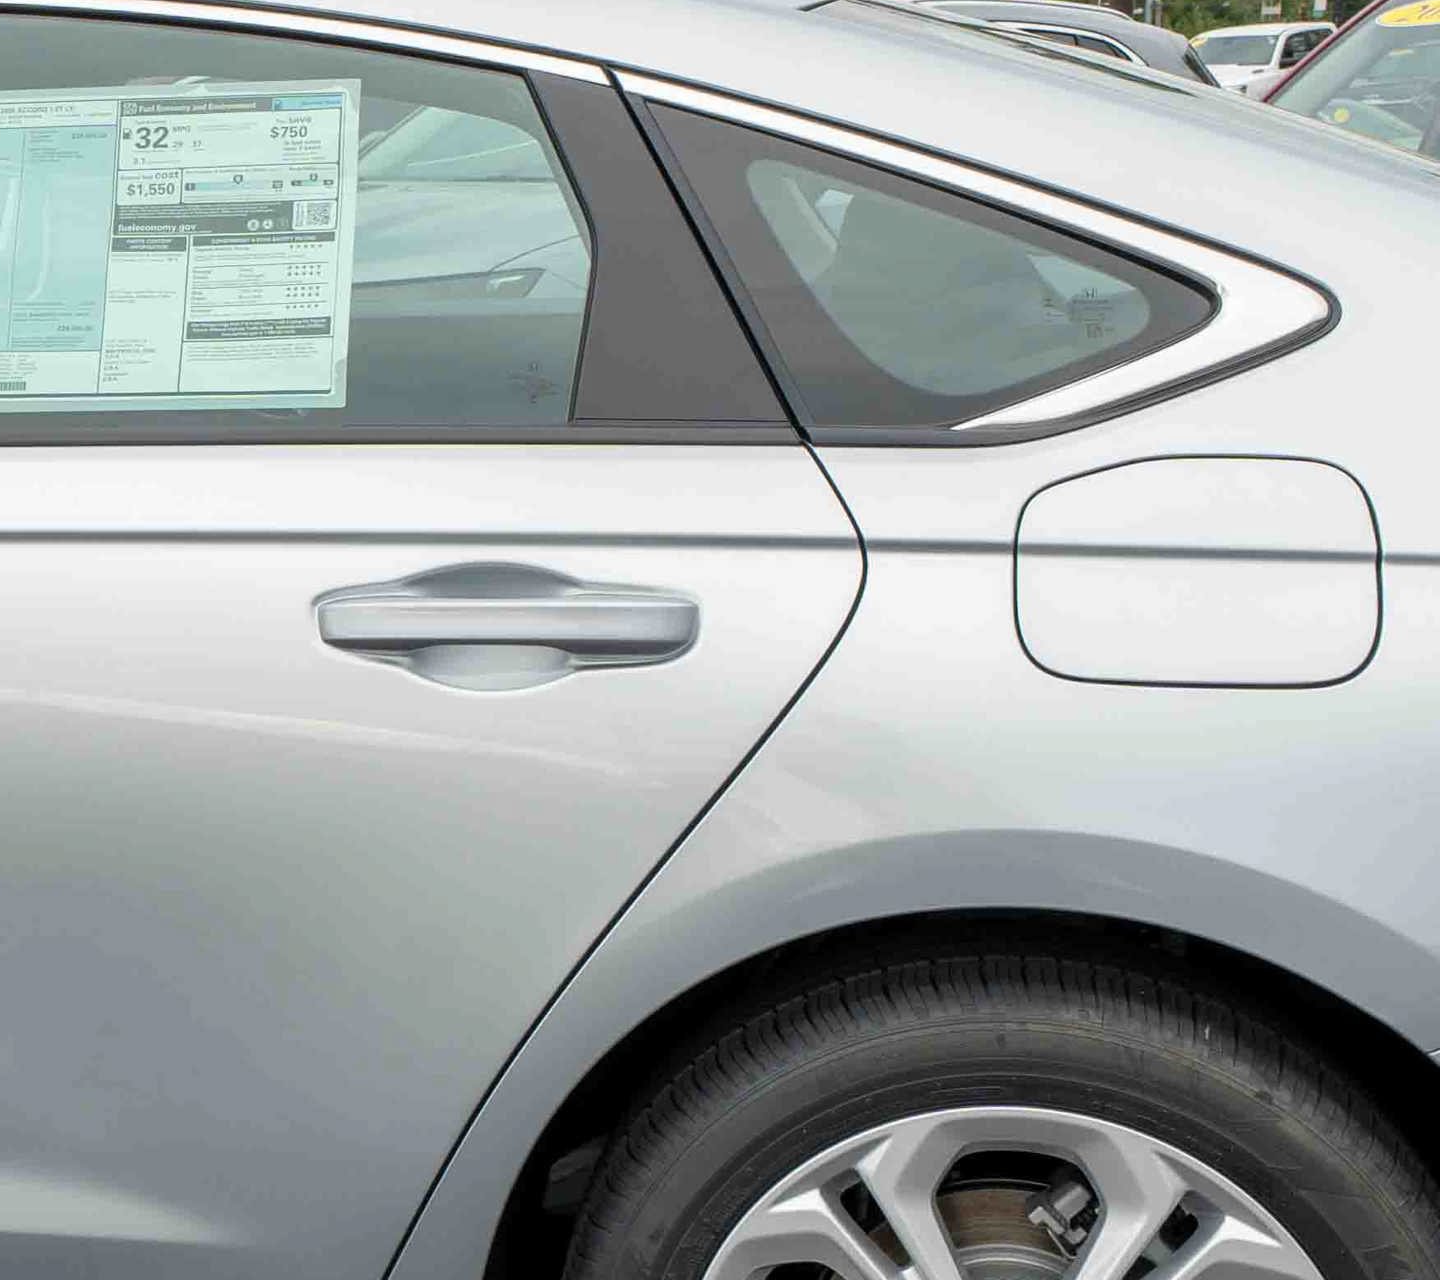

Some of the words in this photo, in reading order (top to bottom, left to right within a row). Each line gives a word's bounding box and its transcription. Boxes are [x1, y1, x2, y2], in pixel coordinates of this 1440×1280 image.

[135, 126, 169, 149] 32
[270, 126, 308, 139] $750
[127, 182, 175, 198] $1,550
[117, 222, 197, 233] fueleconomy.gov
